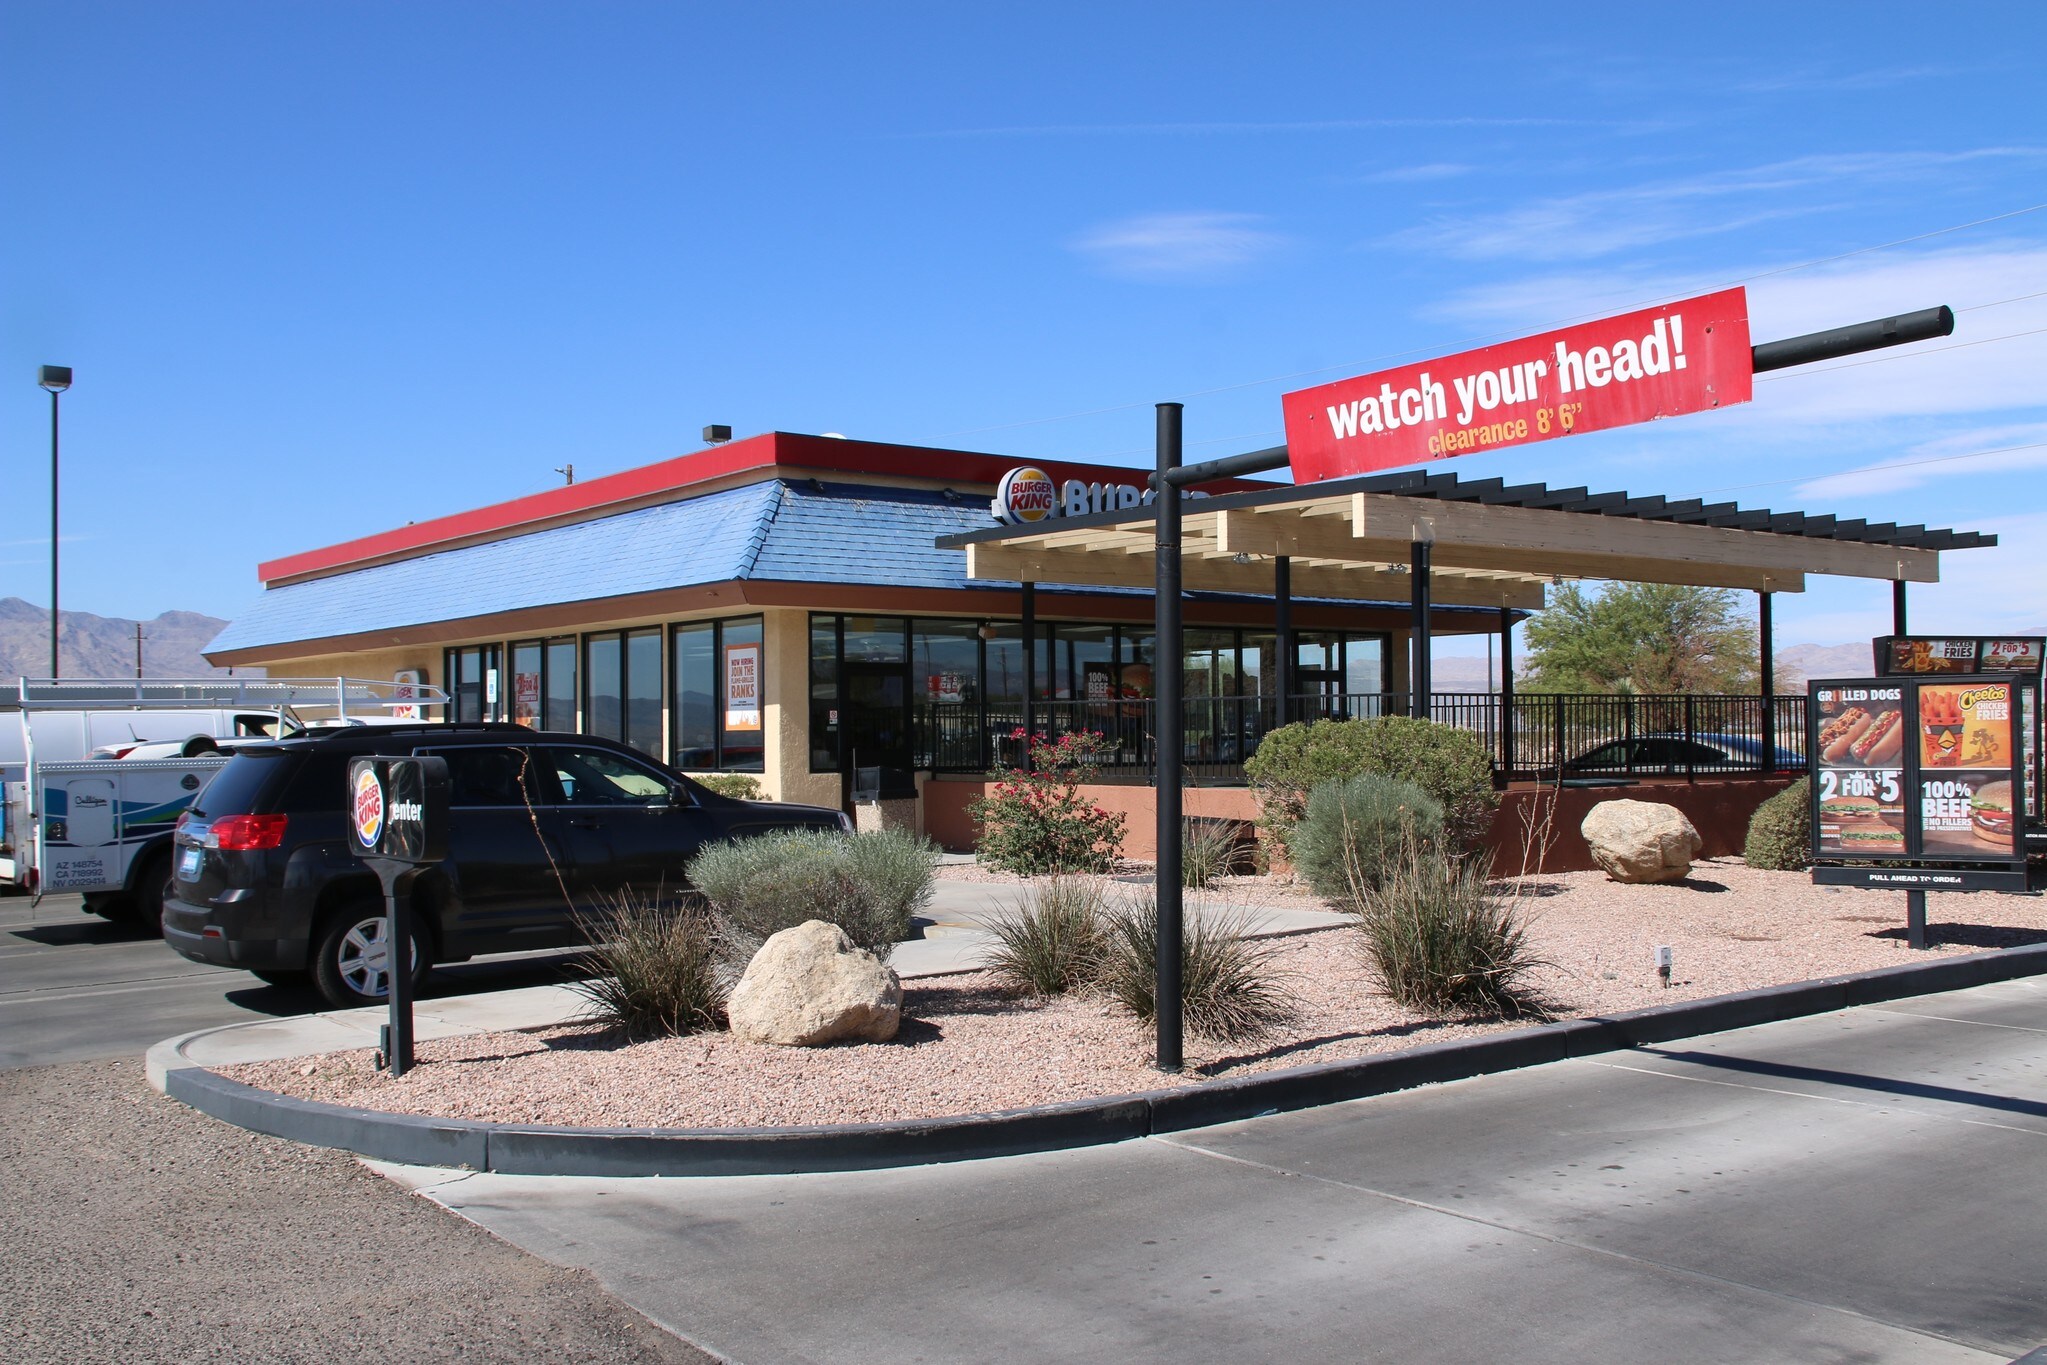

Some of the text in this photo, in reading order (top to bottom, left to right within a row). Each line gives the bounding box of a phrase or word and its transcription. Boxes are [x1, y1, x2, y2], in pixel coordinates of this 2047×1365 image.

[1326, 313, 1688, 440] watch your head!
[1427, 418, 1529, 455] clearance
[1011, 481, 1053, 495] BURGER
[1009, 493, 1053, 511] KING
[1943, 647, 1973, 658] FRIES
[1991, 640, 2000, 656] 2
[2002, 644, 2018, 654] FOR
[731, 665, 754, 677] JOIN THE
[1088, 671, 1109, 682] 100%
[731, 684, 755, 699] RANKS
[1088, 682, 1109, 694] BEEF
[1870, 688, 1901, 701] DOGS
[1959, 685, 2007, 711] Cheetos
[1976, 702, 2008, 710] CHICKEN
[1976, 710, 2009, 720] FRIES
[1819, 770, 1838, 802] 2
[1841, 778, 1876, 797] FOR
[1921, 780, 1972, 798] 100%
[357, 783, 380, 809] BURGER
[358, 796, 381, 826] KING
[392, 799, 422, 821] enter
[1921, 798, 1972, 818] BEEF
[1929, 817, 1973, 826] NO FILLERS
[55, 860, 103, 870] AZ 148754
[55, 869, 104, 879] CA 718992
[1868, 874, 1890, 882] PULL
[1890, 875, 1918, 883] AHEAD
[53, 879, 66, 888] NV
